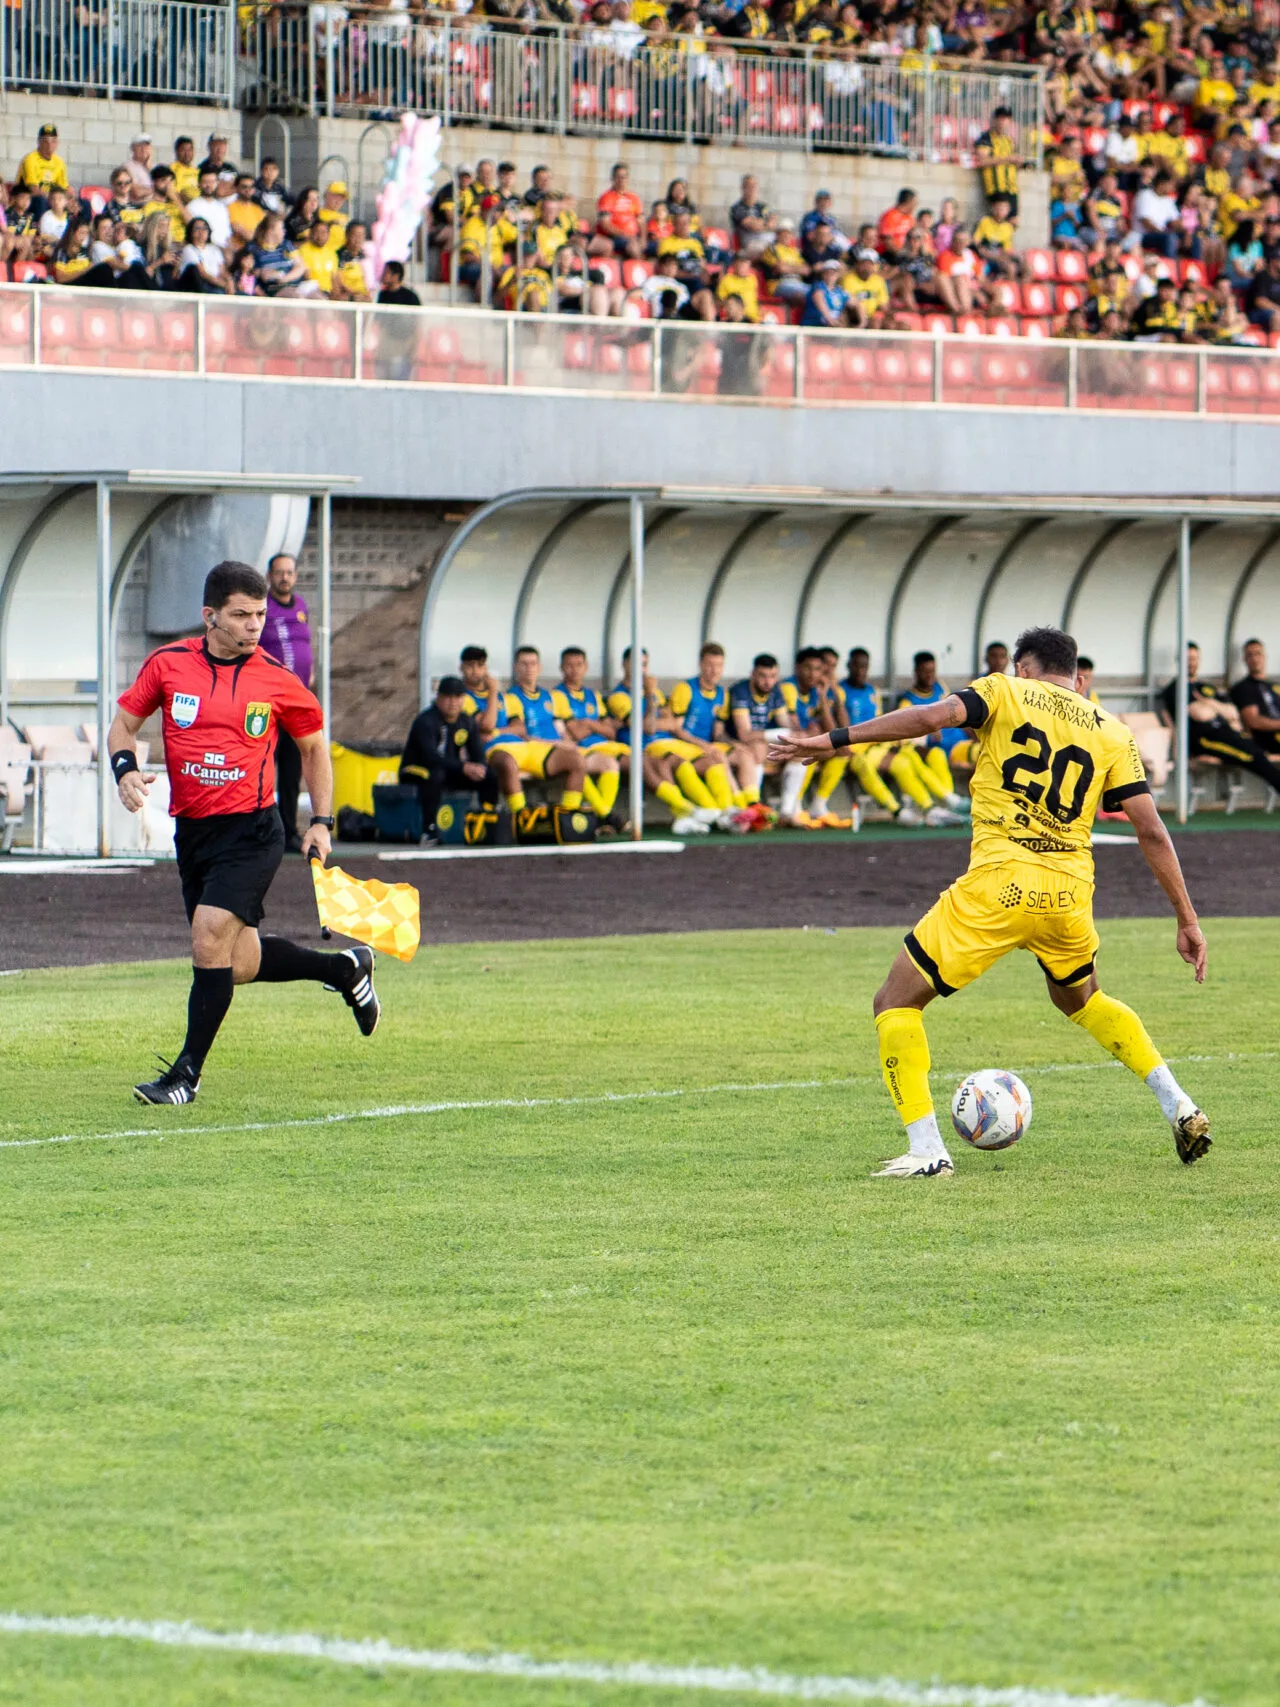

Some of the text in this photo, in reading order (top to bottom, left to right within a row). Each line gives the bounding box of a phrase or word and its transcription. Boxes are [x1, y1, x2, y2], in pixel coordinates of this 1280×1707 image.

[175, 695, 196, 706] FIFA
[1022, 696, 1095, 731] MANTOVANI
[1023, 689, 1095, 721] FERNANDO
[1001, 721, 1095, 824] 20
[1026, 886, 1077, 909] SIEVEX
